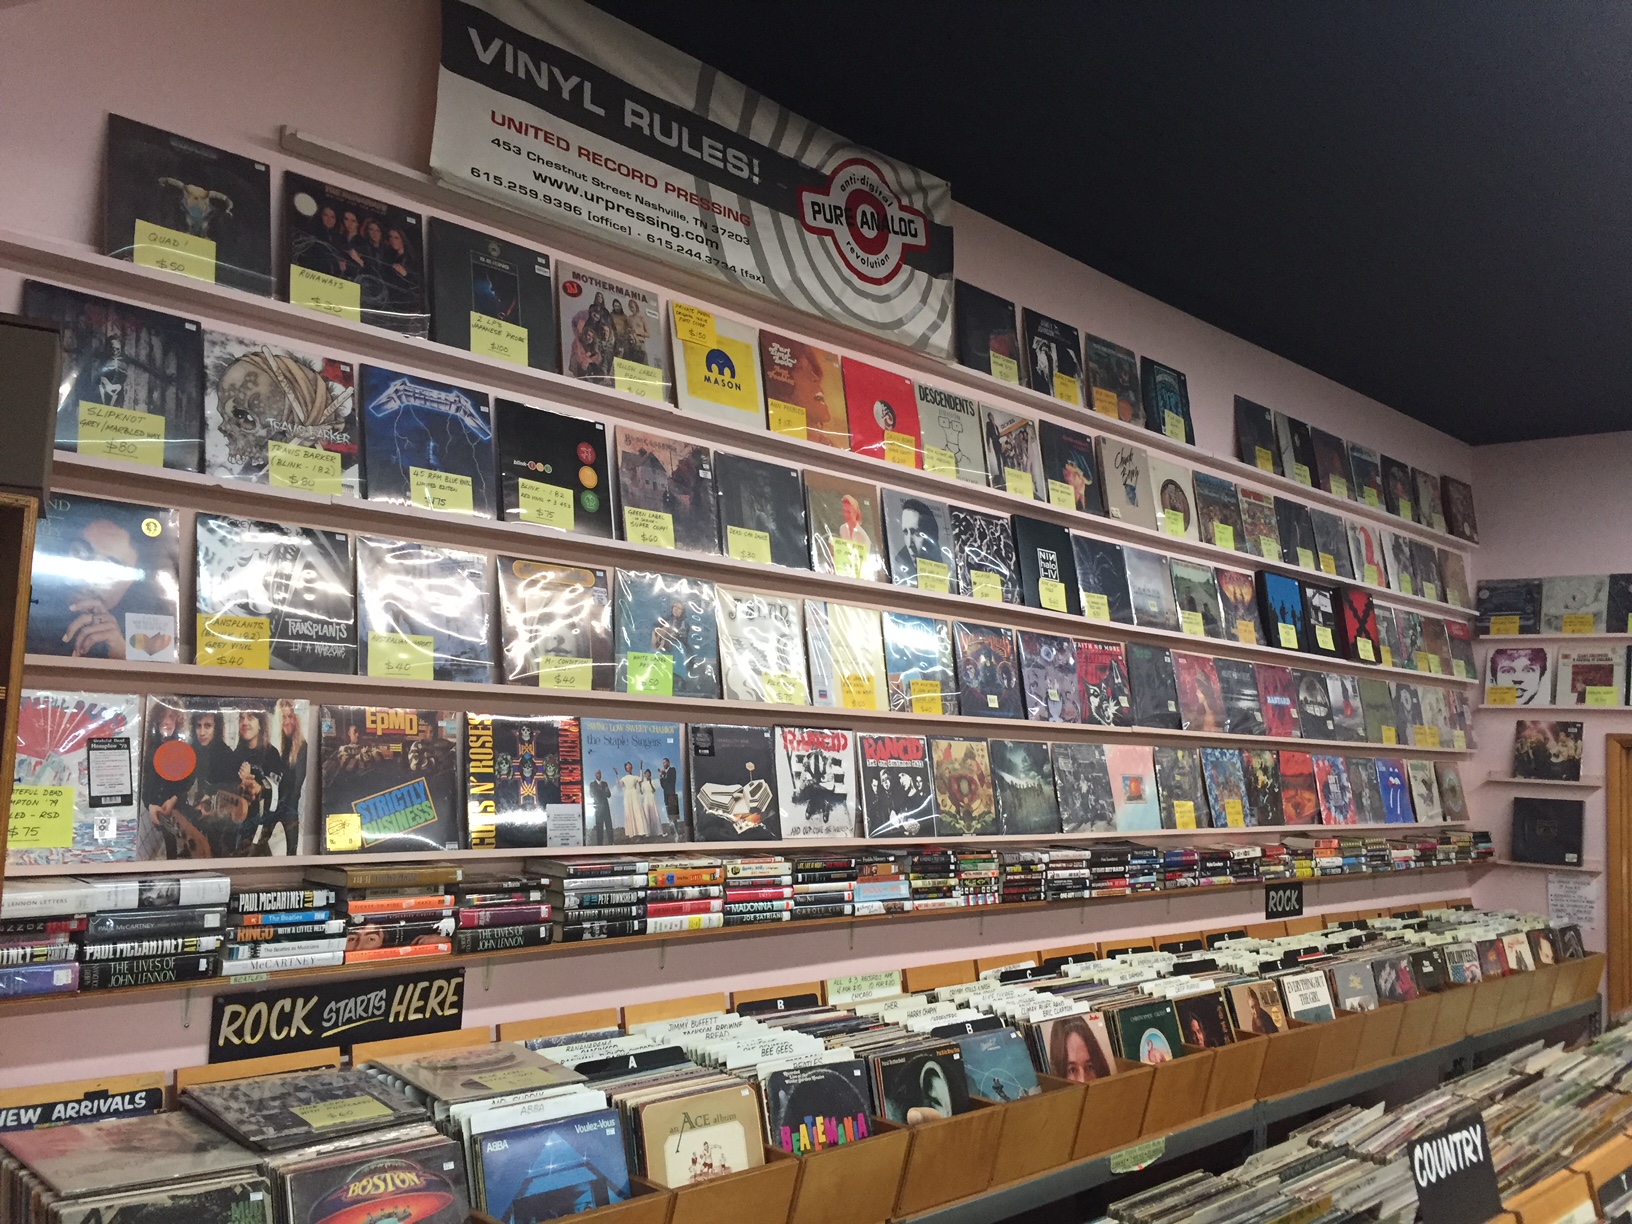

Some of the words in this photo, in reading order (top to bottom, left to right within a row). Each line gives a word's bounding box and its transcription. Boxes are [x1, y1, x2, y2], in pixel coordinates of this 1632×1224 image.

[467, 26, 605, 117] VINYL
[624, 98, 761, 186] RULES!
[490, 110, 571, 153] UNITED
[577, 145, 659, 190] RECORD
[664, 181, 751, 228] PRESSING
[490, 137, 522, 156] 453
[526, 149, 588, 183] Chestnut
[591, 176, 632, 201] Street
[634, 193, 690, 224] Nashville,
[692, 216, 708, 231] TN
[711, 224, 750, 246] 37203
[840, 173, 894, 208] anti-digital
[532, 170, 720, 251] www.urpressing.com
[470, 166, 583, 217] 615.259.9396
[646, 233, 737, 274] 615.244.3734
[810, 200, 855, 227] PURE
[860, 209, 918, 239] ANALOG
[846, 240, 890, 269] revolution
[155, 258, 185, 272] $50
[298, 268, 345, 290] RUNAWAYS
[571, 271, 648, 304] MOTHERMANIA
[472, 322, 503, 336] JAPANESE
[703, 374, 742, 392] MASON
[918, 385, 975, 417] DESCENDENTS
[87, 406, 147, 424] SLIPKNOT
[105, 440, 137, 455] $80
[271, 444, 301, 457] TRAVIS
[302, 450, 337, 464] BARKER
[270, 455, 302, 469] (BLINK
[1114, 447, 1134, 469] Chuck
[289, 473, 316, 487] $80
[413, 470, 425, 478] 45
[444, 476, 459, 485] BLUE
[628, 510, 646, 518] GREEN
[729, 527, 742, 536] DEAD
[1040, 561, 1057, 570] halo
[203, 617, 264, 629] TANSPLANTS
[285, 618, 348, 640] TRANSPLANTS
[205, 641, 227, 650] GREY
[216, 656, 244, 666] $40
[384, 660, 411, 672] $40
[554, 674, 576, 685] $40
[609, 724, 624, 733] LOW
[626, 725, 647, 734] SWEET
[468, 714, 494, 773] ROSES
[587, 734, 600, 745] the
[603, 735, 629, 749] Staple
[631, 736, 662, 749] Singers
[782, 729, 848, 752] RANCID
[863, 737, 924, 761] RANCID
[43, 789, 63, 797] DEAD
[356, 780, 429, 824] STRICTLY
[362, 800, 436, 843] BUSINESS
[8, 827, 41, 838] $75
[7, 900, 38, 908] LENNON
[39, 898, 68, 906] LETTERS
[239, 892, 258, 912] PAUL
[731, 901, 774, 912] MADONNA
[1268, 889, 1300, 912] ROCK
[269, 914, 279, 922] The
[280, 913, 303, 921] Beatles
[743, 914, 754, 922] JOE
[796, 907, 825, 915] CAROLE
[116, 922, 155, 931] McCARTNEY
[237, 926, 274, 942] RINGO
[278, 927, 289, 935] WITH
[296, 926, 312, 934] LITTLE
[477, 929, 492, 940] THE
[494, 928, 515, 937] LIVES
[515, 927, 524, 936] OF
[273, 945, 290, 953] Beatles
[477, 940, 497, 951] JOHN
[497, 937, 524, 948] LENNON
[86, 944, 115, 960] PAUL
[110, 960, 129, 974] THE
[133, 959, 162, 972] LIVES
[163, 958, 176, 970] OF
[1277, 960, 1283, 970] E
[108, 972, 136, 988] JOHN
[138, 970, 177, 985] LENNON
[1026, 969, 1032, 979] C
[1286, 976, 1313, 993] EVERYTHING
[1313, 975, 1325, 987] BUT
[851, 990, 873, 1001] CHICAGO
[1298, 993, 1309, 1005] THE
[1308, 991, 1321, 1004] GIRL
[218, 994, 320, 1047] ROCK
[322, 988, 386, 1029] STARTS
[388, 976, 463, 1023] HERE
[776, 999, 785, 1010] B
[884, 1001, 898, 1011] CHER
[1042, 1009, 1053, 1017] ERIC
[1054, 1005, 1073, 1015] CLAPTON
[907, 1010, 922, 1018] HARRY
[922, 1007, 938, 1016] CHAPIN
[668, 1018, 689, 1032] JIMMY
[690, 1016, 719, 1029] BUFFETT
[966, 1023, 973, 1034] B
[761, 1046, 774, 1057] BEE
[775, 1044, 794, 1056] GEES
[628, 1055, 637, 1069] A
[0, 1106, 47, 1127] NEW
[52, 1091, 147, 1121] ARRIVALS
[520, 1104, 545, 1116] ABBA
[574, 1118, 616, 1134] Voulez-Vous
[668, 1125, 680, 1134] an
[712, 1113, 737, 1126] album
[781, 1112, 868, 1157] BEATLEMANIA
[486, 1139, 509, 1153] ABBA
[1413, 1123, 1484, 1188] COUNTRY
[348, 1171, 421, 1198] BOSTON
